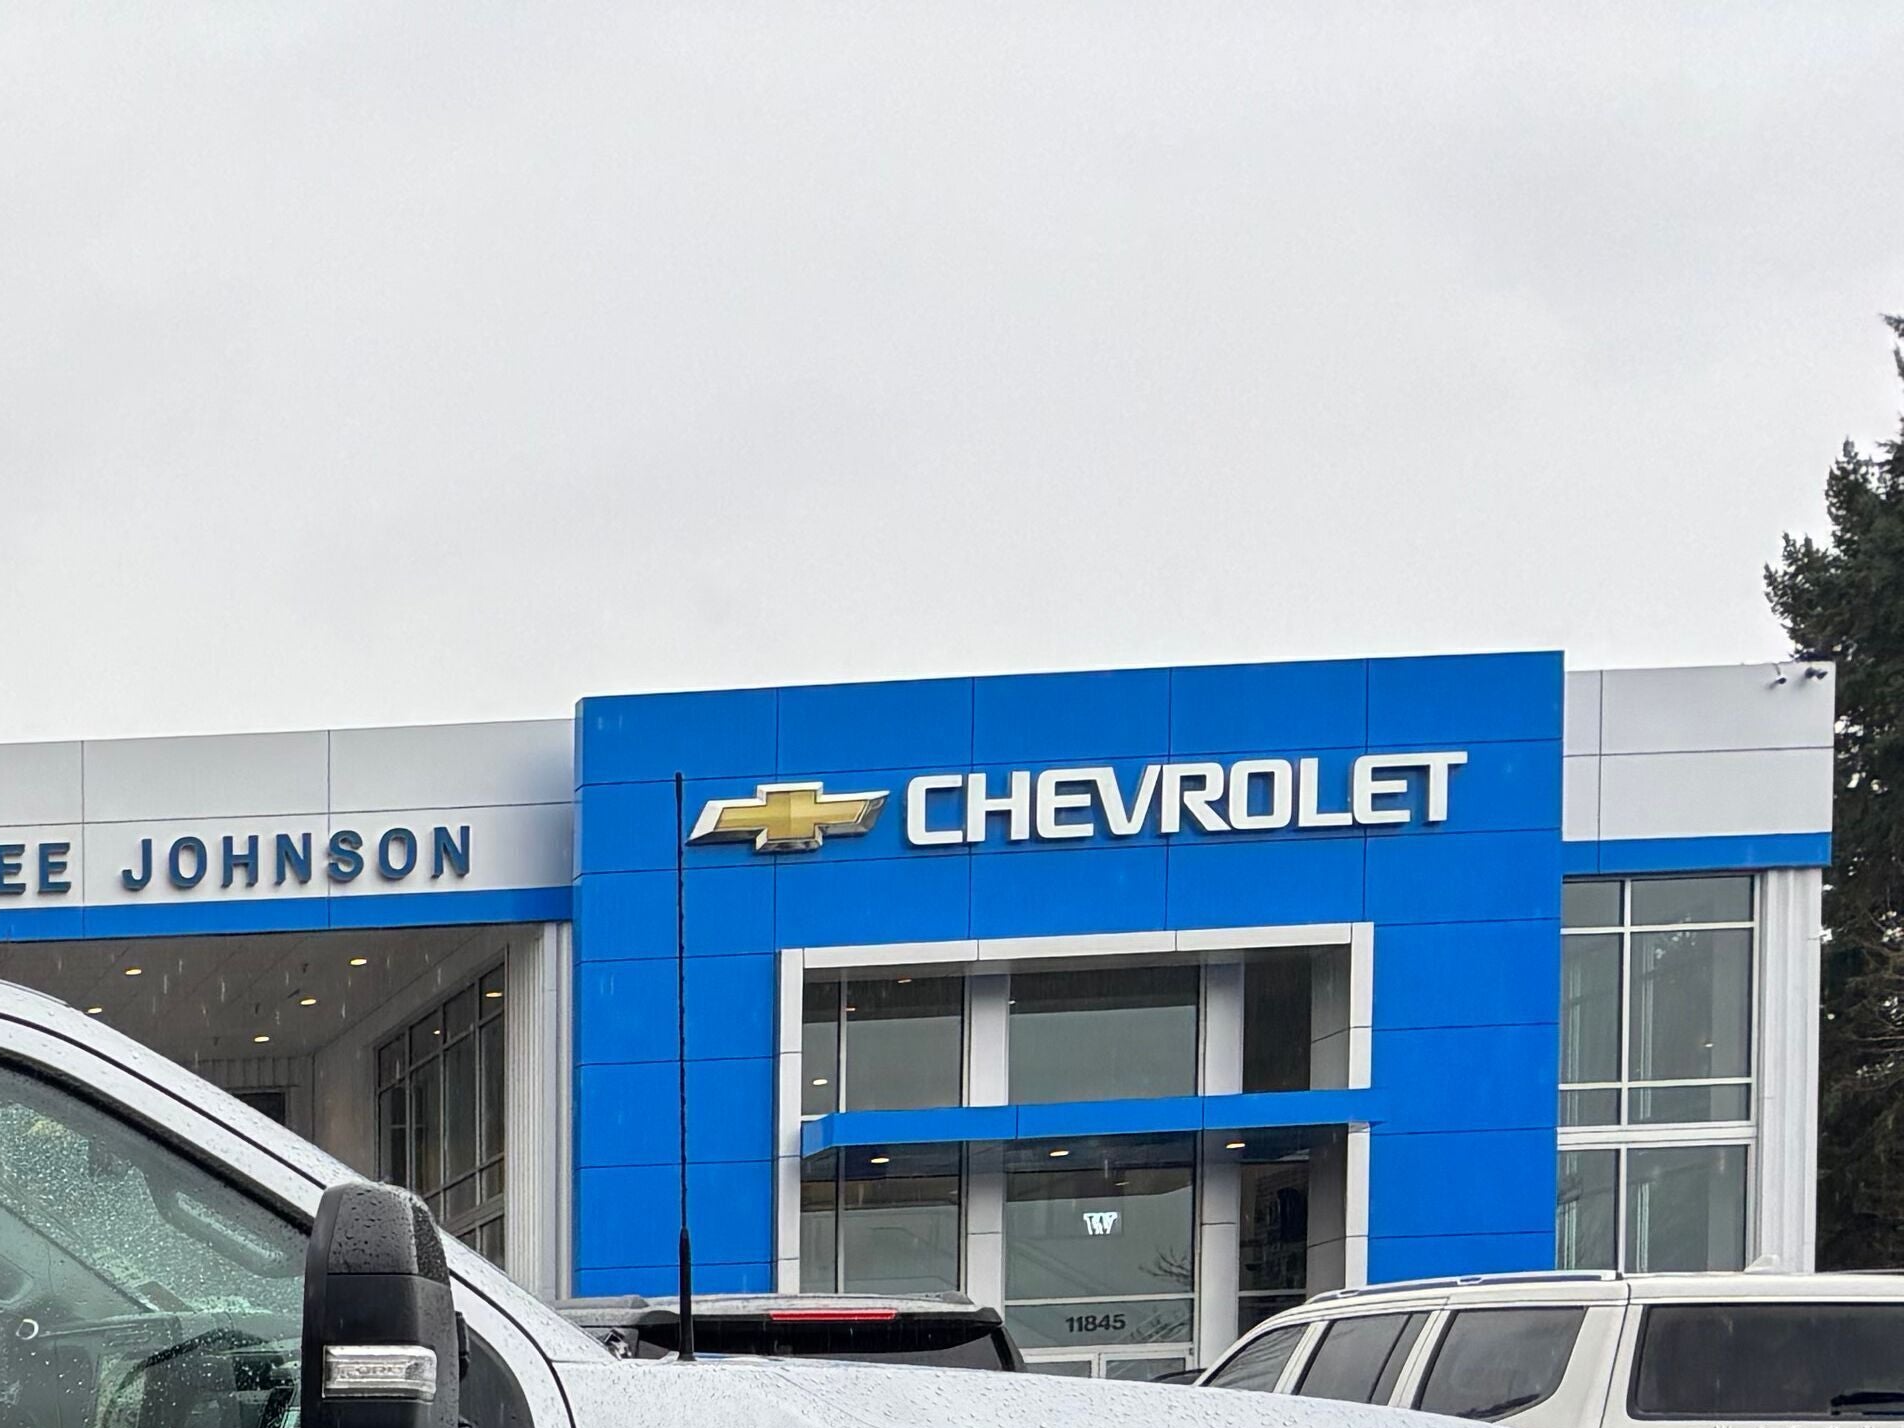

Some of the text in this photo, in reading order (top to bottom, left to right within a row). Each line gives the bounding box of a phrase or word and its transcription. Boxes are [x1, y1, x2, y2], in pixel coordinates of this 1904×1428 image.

[904, 750, 1469, 847] CHEVROLET
[120, 824, 472, 891] JOHNSON
[1065, 1313, 1127, 1334] 11845
